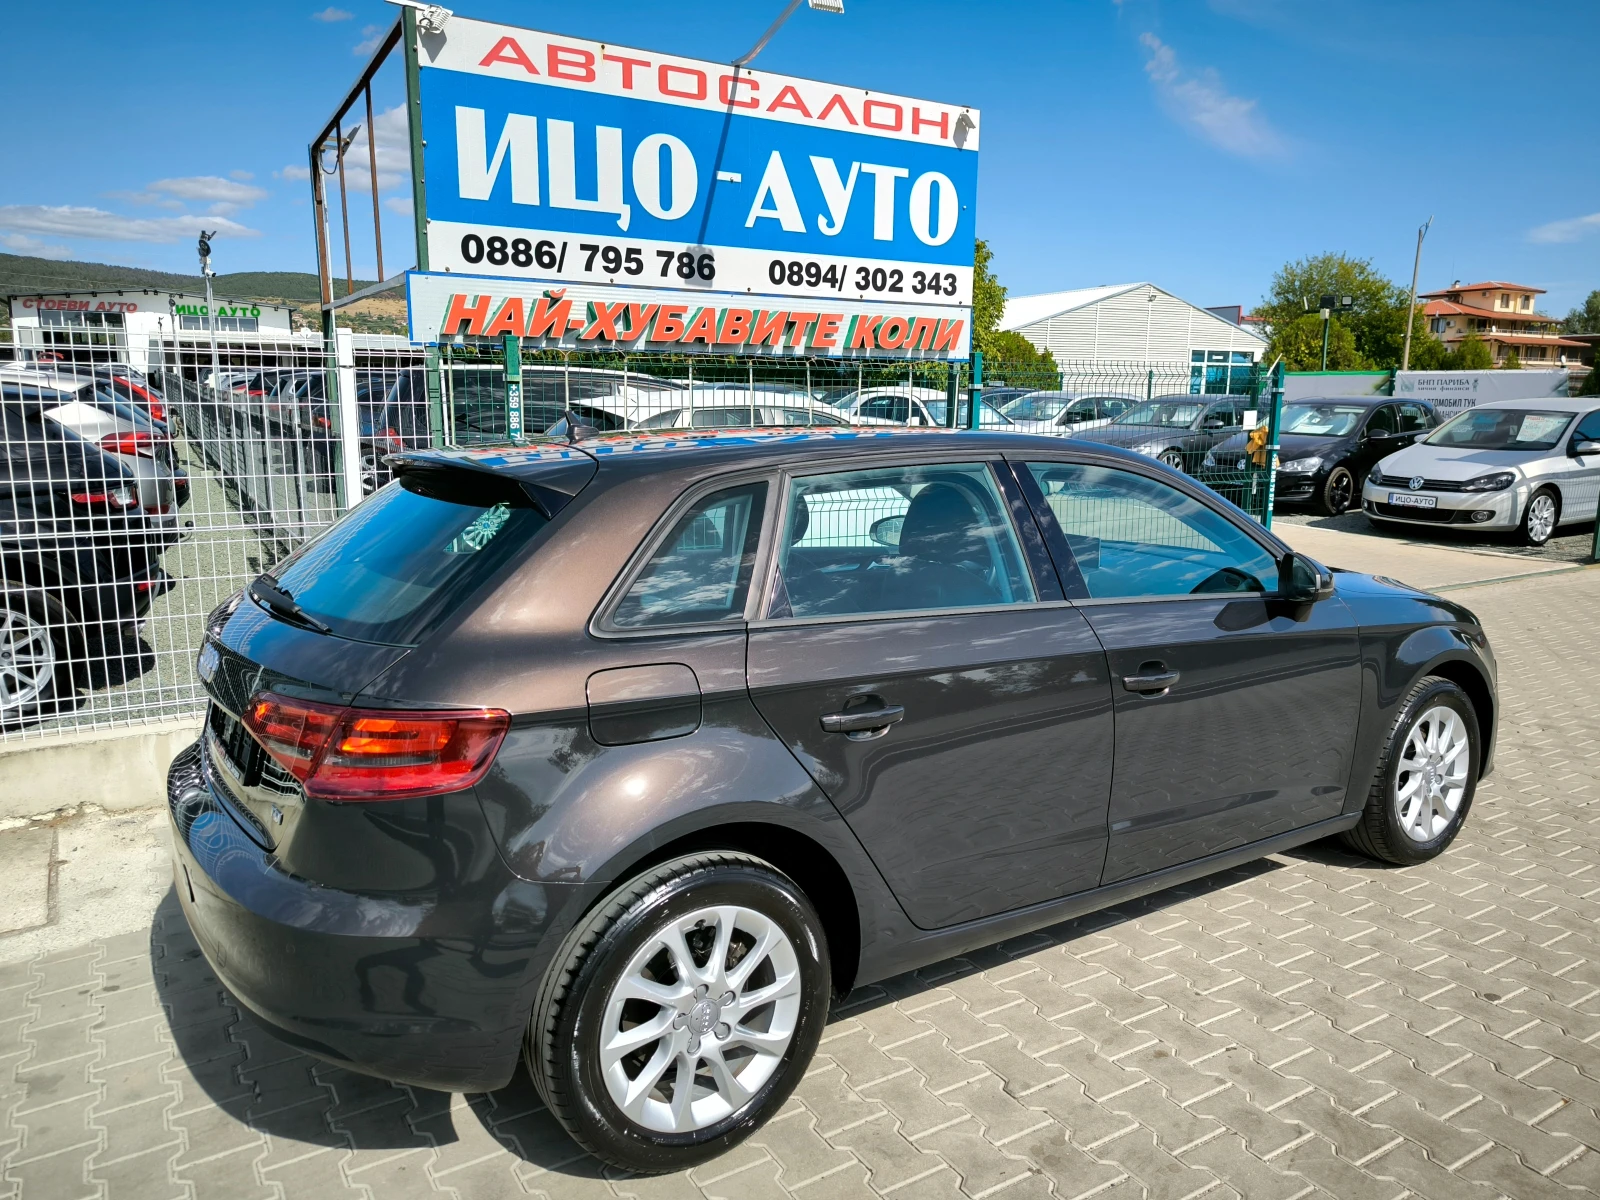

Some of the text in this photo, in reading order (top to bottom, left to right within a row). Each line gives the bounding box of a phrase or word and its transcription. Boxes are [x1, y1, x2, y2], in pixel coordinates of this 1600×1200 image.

[479, 36, 949, 140] АВТОСАЛОН
[461, 233, 716, 283] 0886/ 795 786
[768, 259, 958, 297] 0894/ 302 343
[22, 298, 138, 313] СТОЕВИ АУТО
[443, 288, 964, 352] НАЙ-ХУБАВИТЕ КОЛИ
[509, 384, 519, 408] +359
[1424, 398, 1476, 408] ТОМОБИЛ ТУК
[509, 411, 520, 428] 886
[1395, 496, 1434, 505] ИЦО-АУТО
